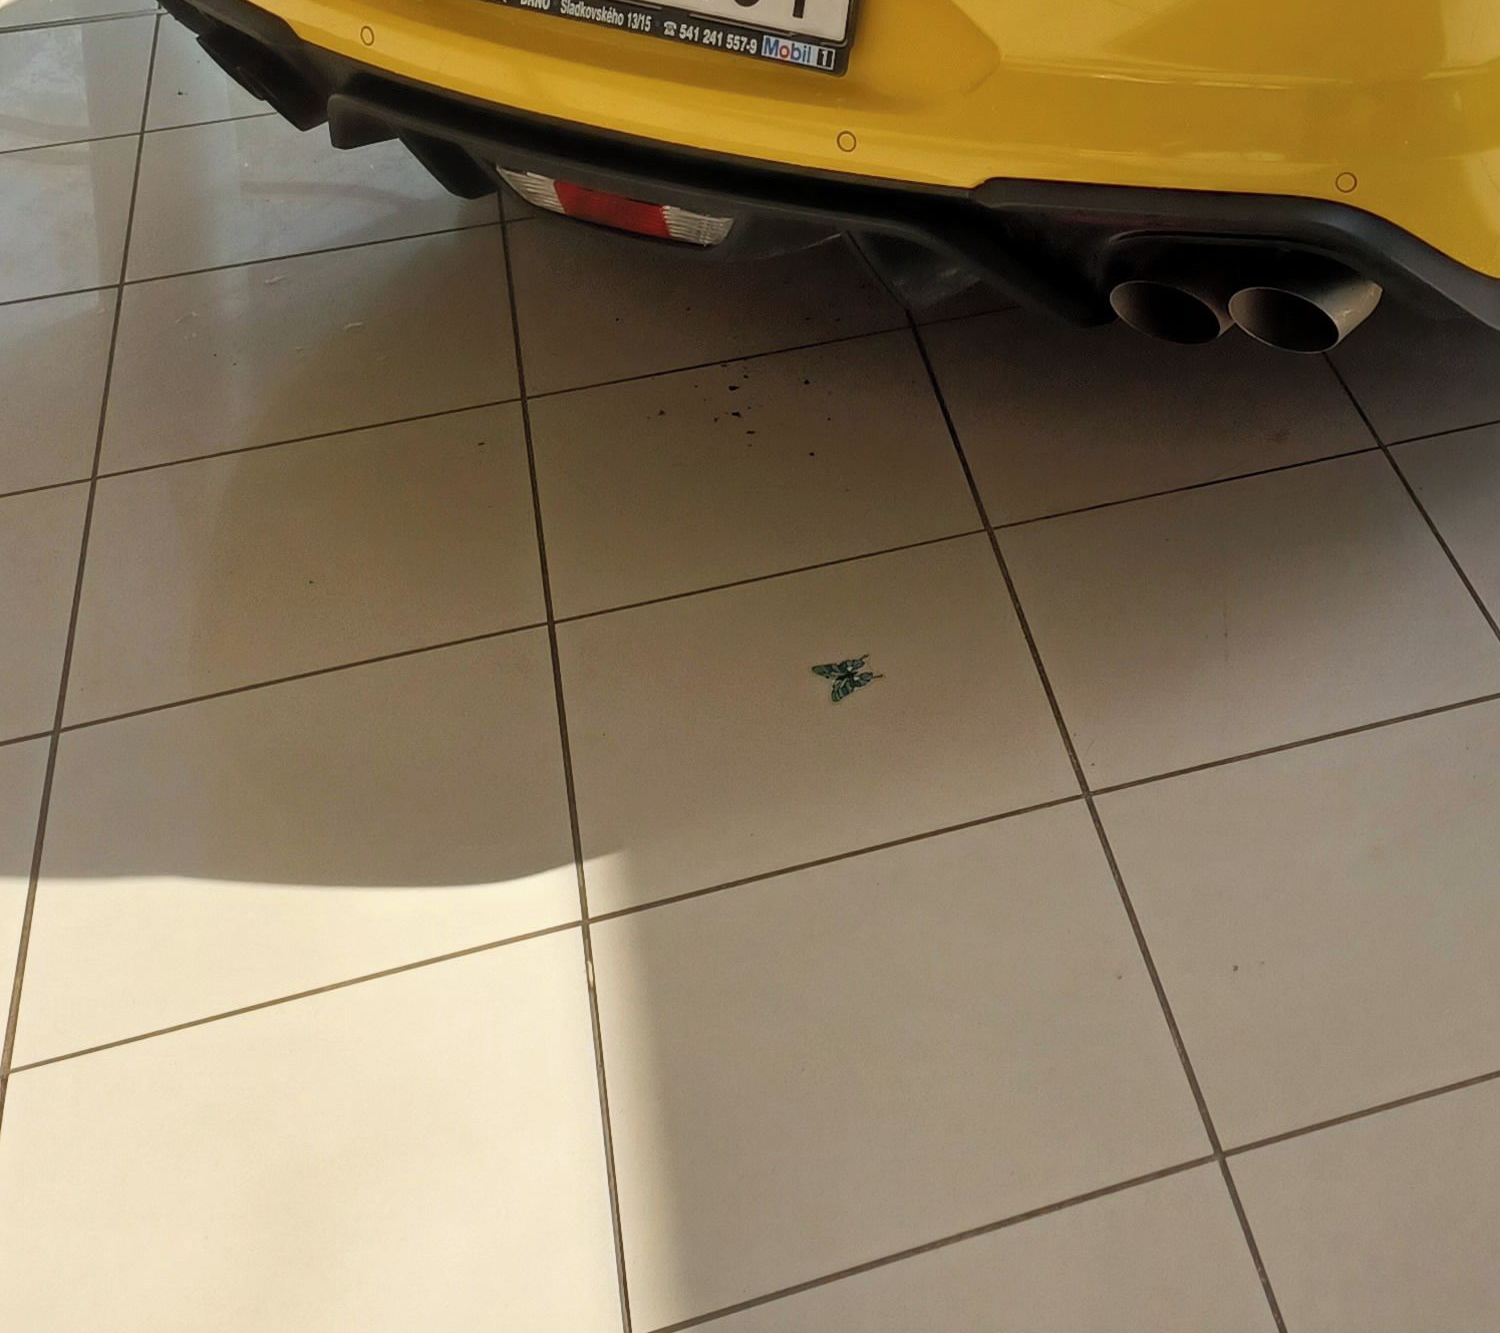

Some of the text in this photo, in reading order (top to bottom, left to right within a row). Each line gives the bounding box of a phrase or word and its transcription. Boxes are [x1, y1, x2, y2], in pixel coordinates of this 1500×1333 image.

[627, 12, 652, 32] 13/15
[679, 23, 700, 42] 541
[702, 28, 723, 47] 241
[726, 35, 758, 55] 557-9
[763, 37, 812, 64] Mobil
